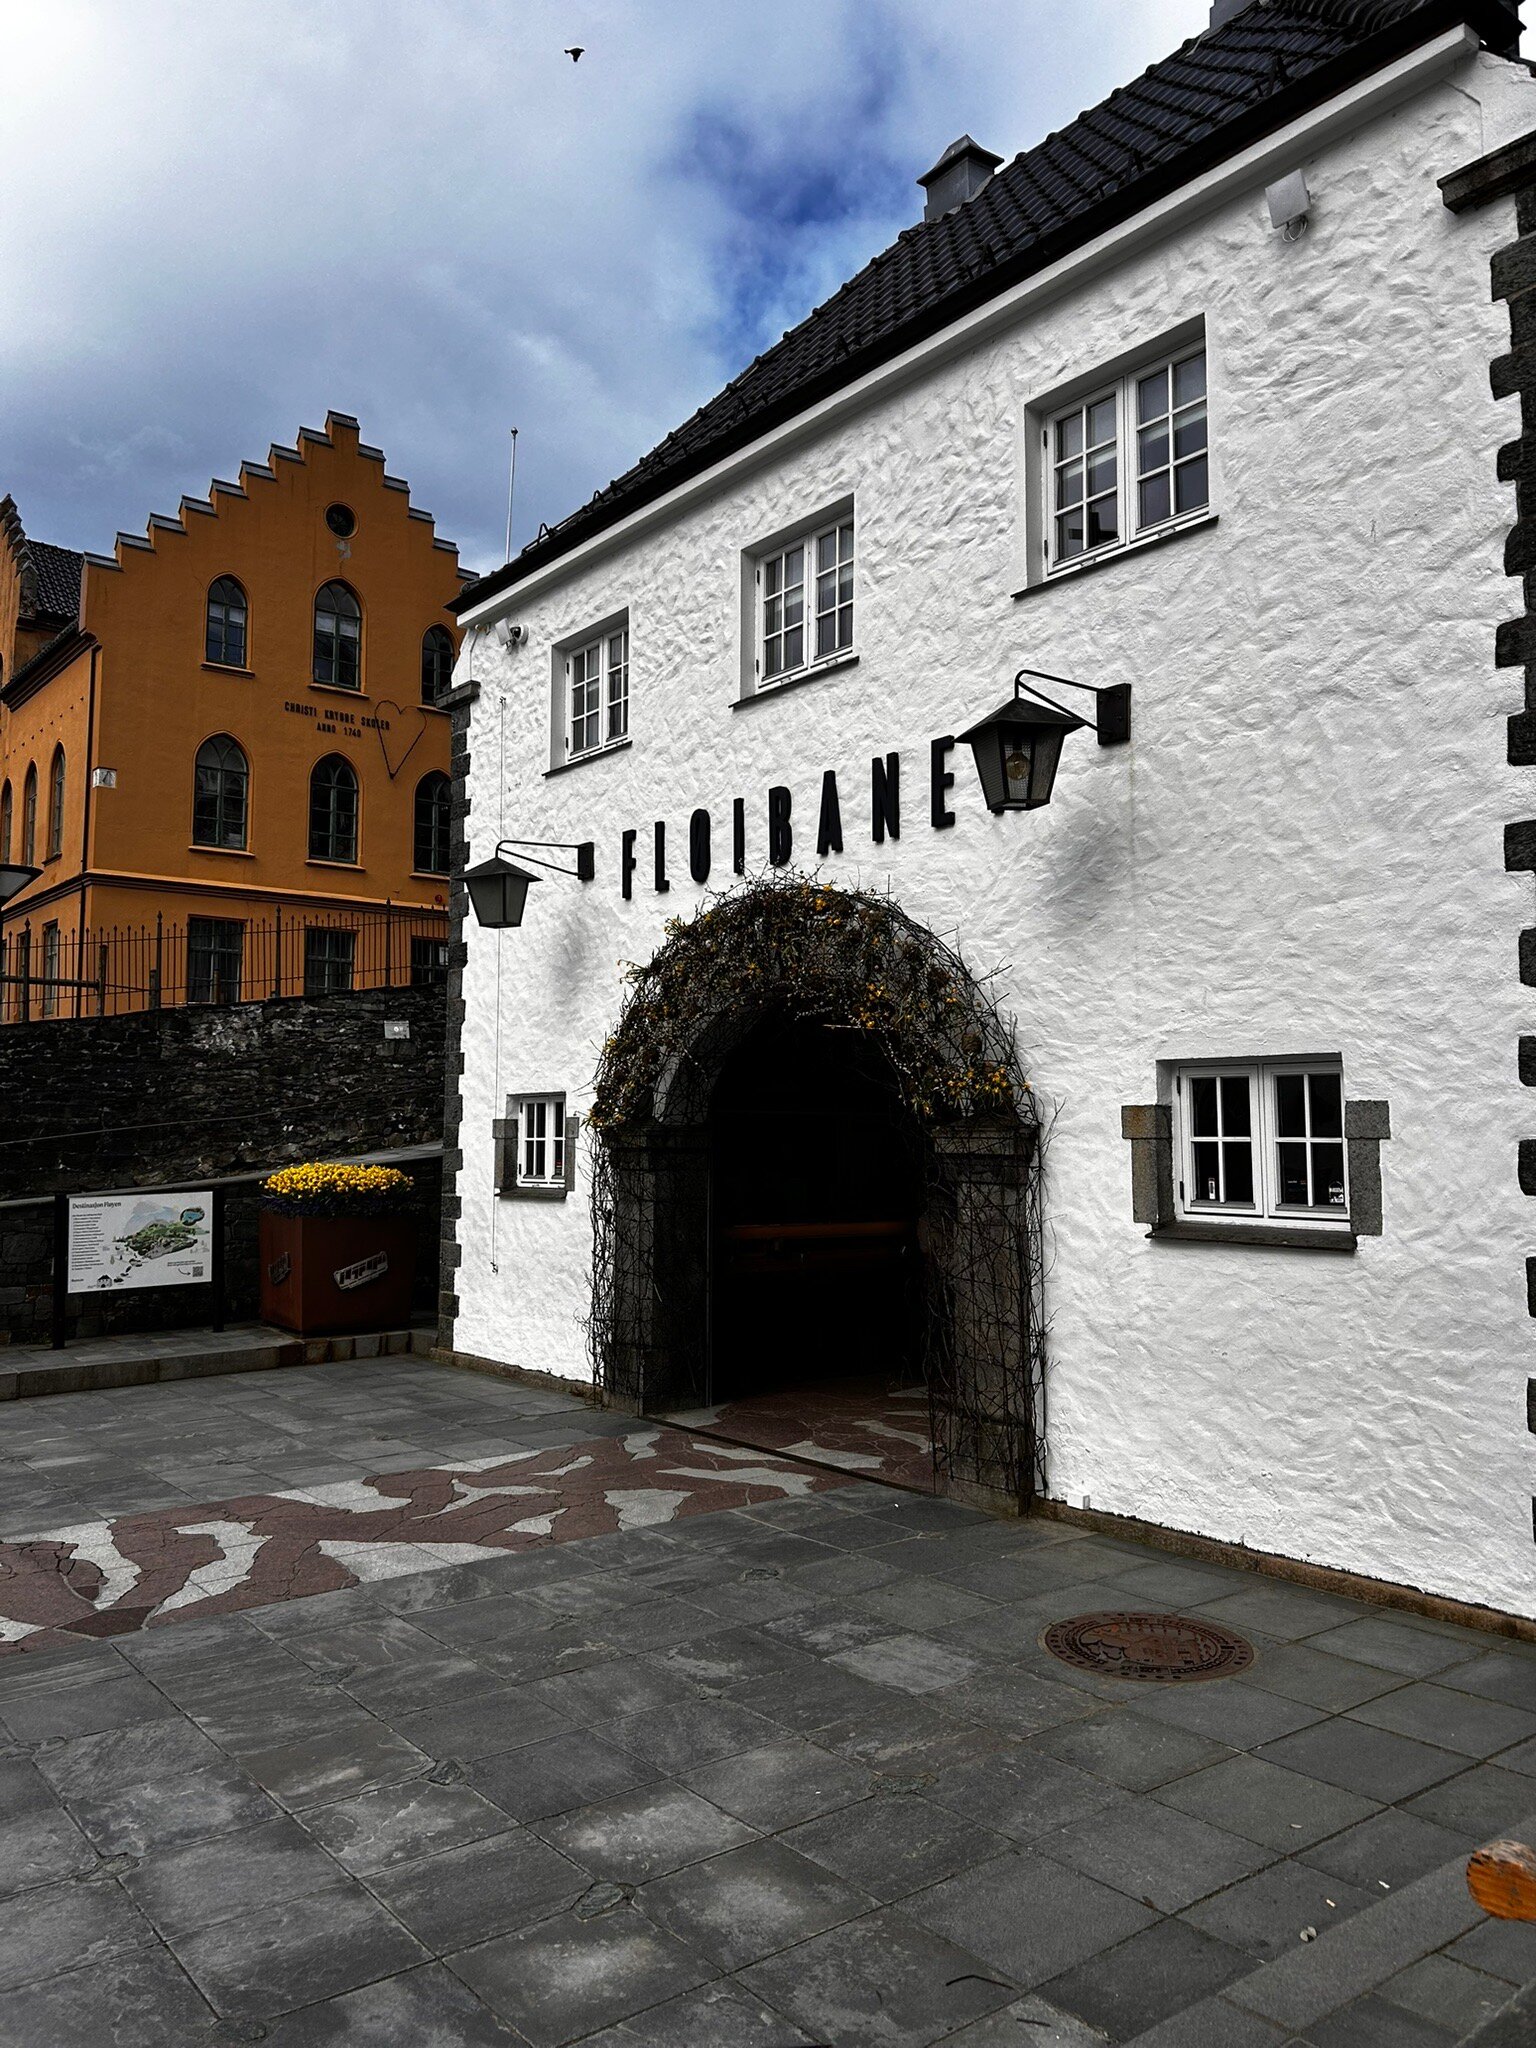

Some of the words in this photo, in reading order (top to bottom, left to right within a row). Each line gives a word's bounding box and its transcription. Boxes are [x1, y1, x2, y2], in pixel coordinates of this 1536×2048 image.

[284, 701, 317, 717] CHRISTI
[316, 722, 336, 734] ANNO
[621, 734, 1005, 900] FLØIBANE
